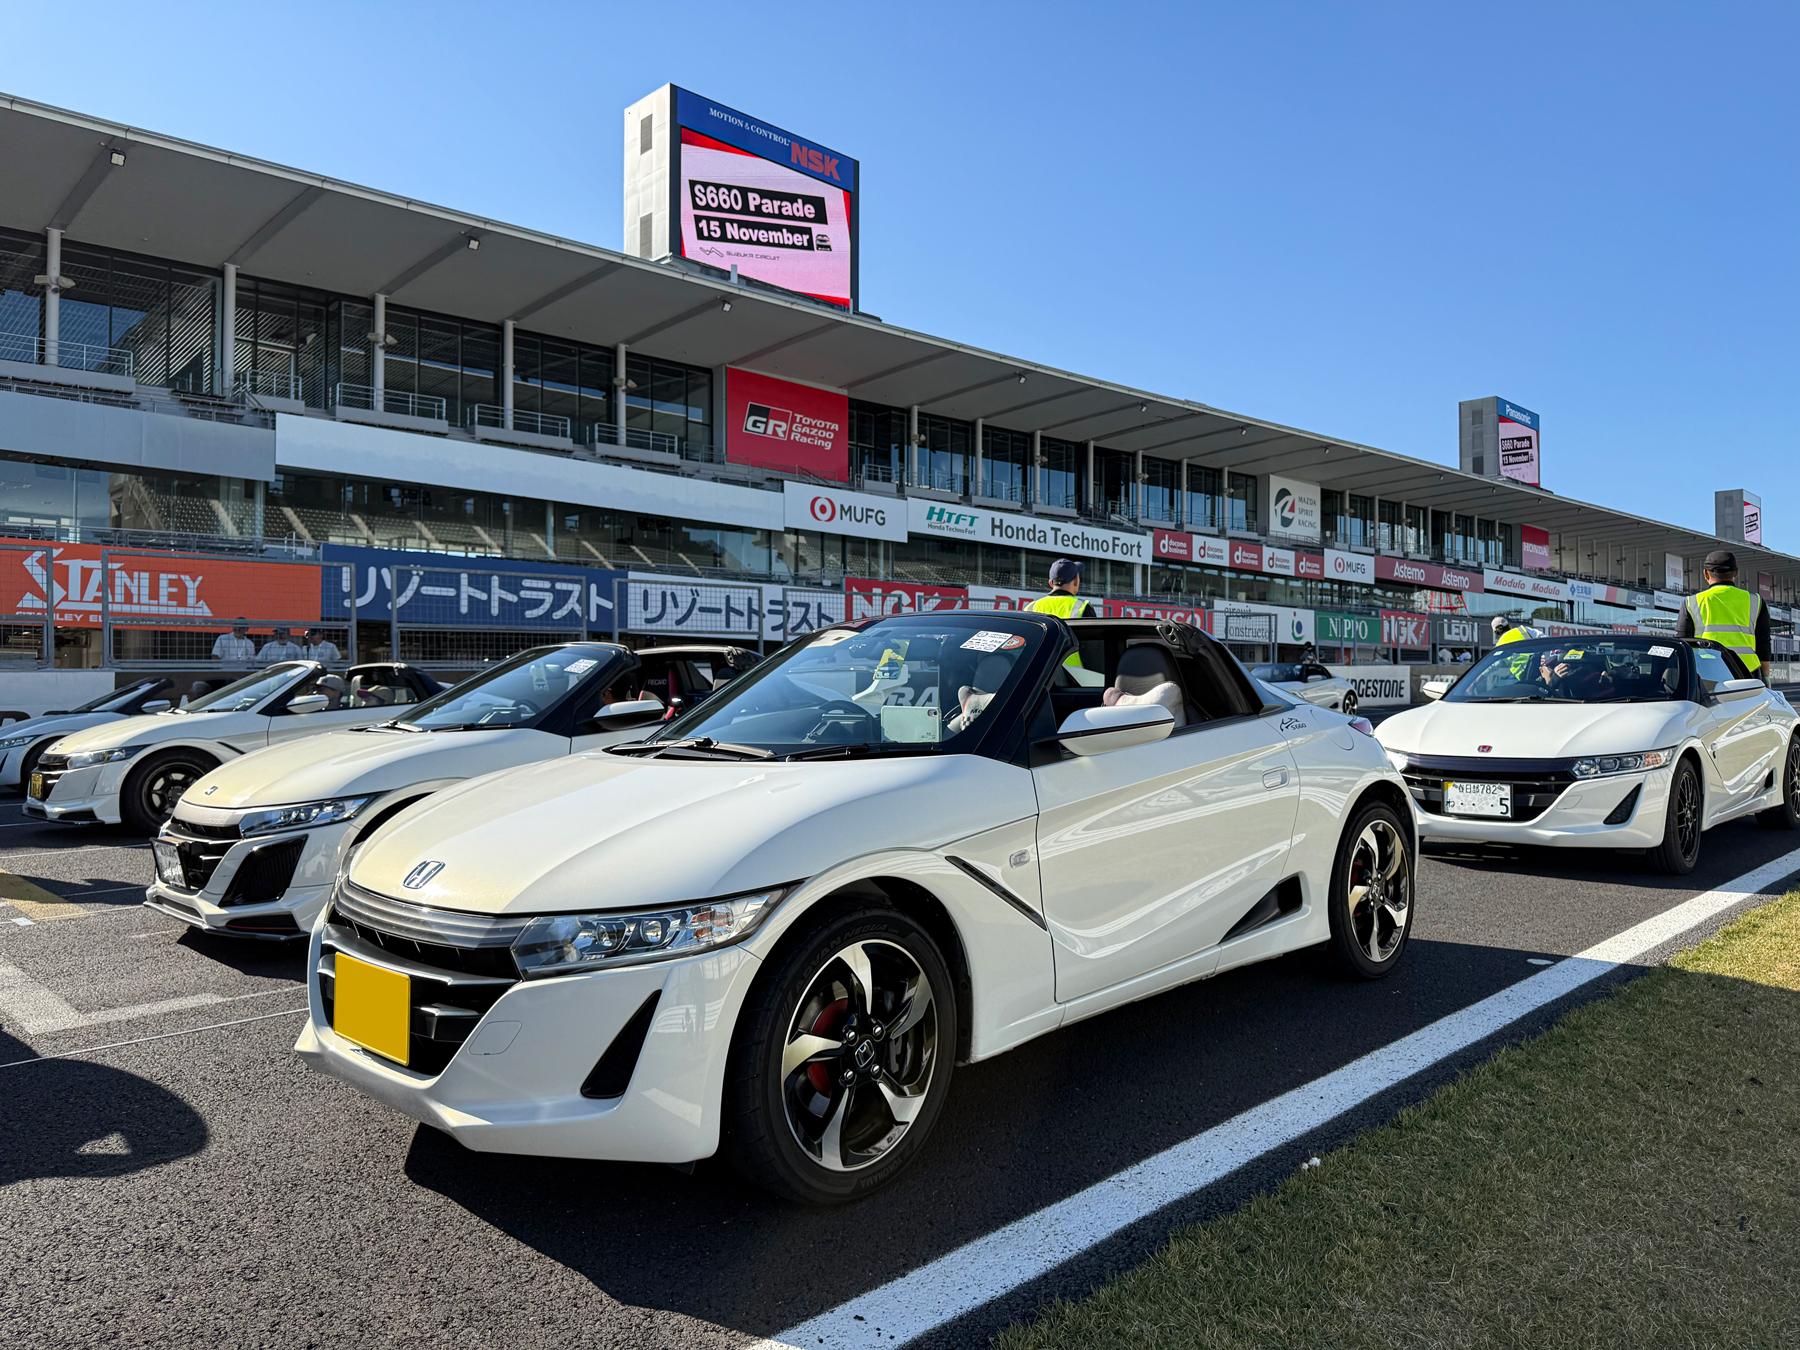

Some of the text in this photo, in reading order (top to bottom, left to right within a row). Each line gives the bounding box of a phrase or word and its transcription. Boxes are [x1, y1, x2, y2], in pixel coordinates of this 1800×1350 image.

[709, 107, 790, 146] MOTION & CONTROL
[791, 141, 841, 181] NSK
[694, 184, 816, 219] S660 Parade
[698, 219, 810, 247] 15 November
[726, 250, 754, 258] SUZUKA
[794, 413, 839, 432] TOYOTA
[1506, 404, 1531, 425] Panasonic
[746, 415, 788, 438] GR
[792, 423, 834, 439] GAZOO
[790, 432, 832, 450] Racing
[1514, 438, 1530, 449] Parade
[1509, 454, 1529, 464] November
[1298, 496, 1316, 506] MAZDA
[840, 503, 886, 526] MUFG
[926, 506, 980, 527] HTFT
[1298, 508, 1313, 517] SPIRIT
[928, 522, 976, 536] Honda Techno Fort
[1298, 519, 1317, 529] RACING
[991, 517, 1142, 558] Honda Techno Fort
[1169, 539, 1187, 548] docomo
[1169, 546, 1187, 555] business
[1207, 545, 1224, 554] docomo
[1207, 552, 1224, 560] business
[1242, 551, 1258, 560] docomo
[1523, 542, 1548, 556] HONDA
[1242, 557, 1258, 566] business
[1275, 556, 1290, 564] docomo
[1275, 562, 1290, 570] business
[1346, 561, 1366, 575] MUFG
[16, 547, 208, 612] STANLEY
[1393, 561, 1425, 582] Astemo
[1441, 570, 1470, 589] Astemo
[341, 564, 614, 622] リゾートトラスト
[1494, 576, 1560, 596] Modulo Modulo
[642, 588, 834, 632] リゾートトラスト
[1329, 618, 1368, 639] NIPPO
[1383, 615, 1417, 646] NGK
[859, 1156, 903, 1188] YOKOHAMA
